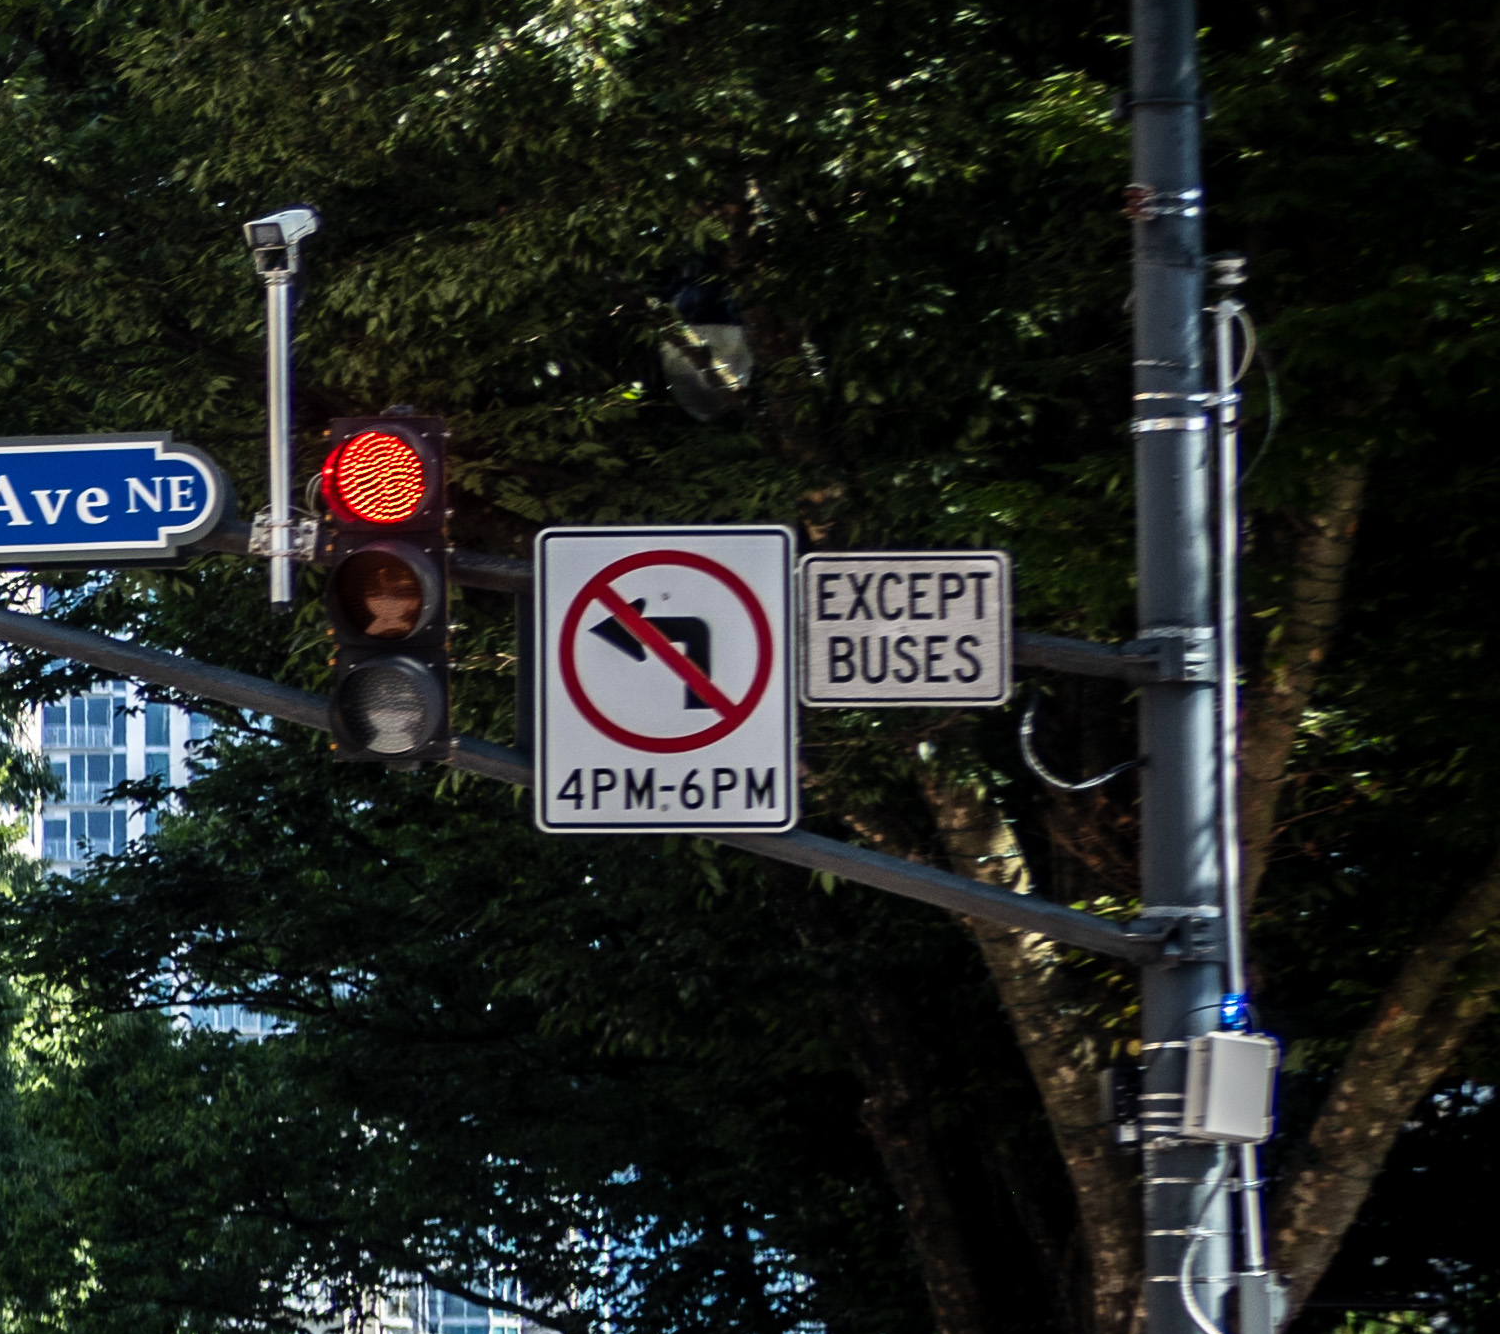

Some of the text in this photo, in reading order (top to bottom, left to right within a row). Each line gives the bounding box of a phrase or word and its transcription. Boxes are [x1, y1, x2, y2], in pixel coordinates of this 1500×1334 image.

[123, 473, 197, 516] NE
[816, 571, 993, 622] EXCEPT
[828, 634, 983, 685] BUSES
[556, 766, 777, 811] 4PM-6PM
